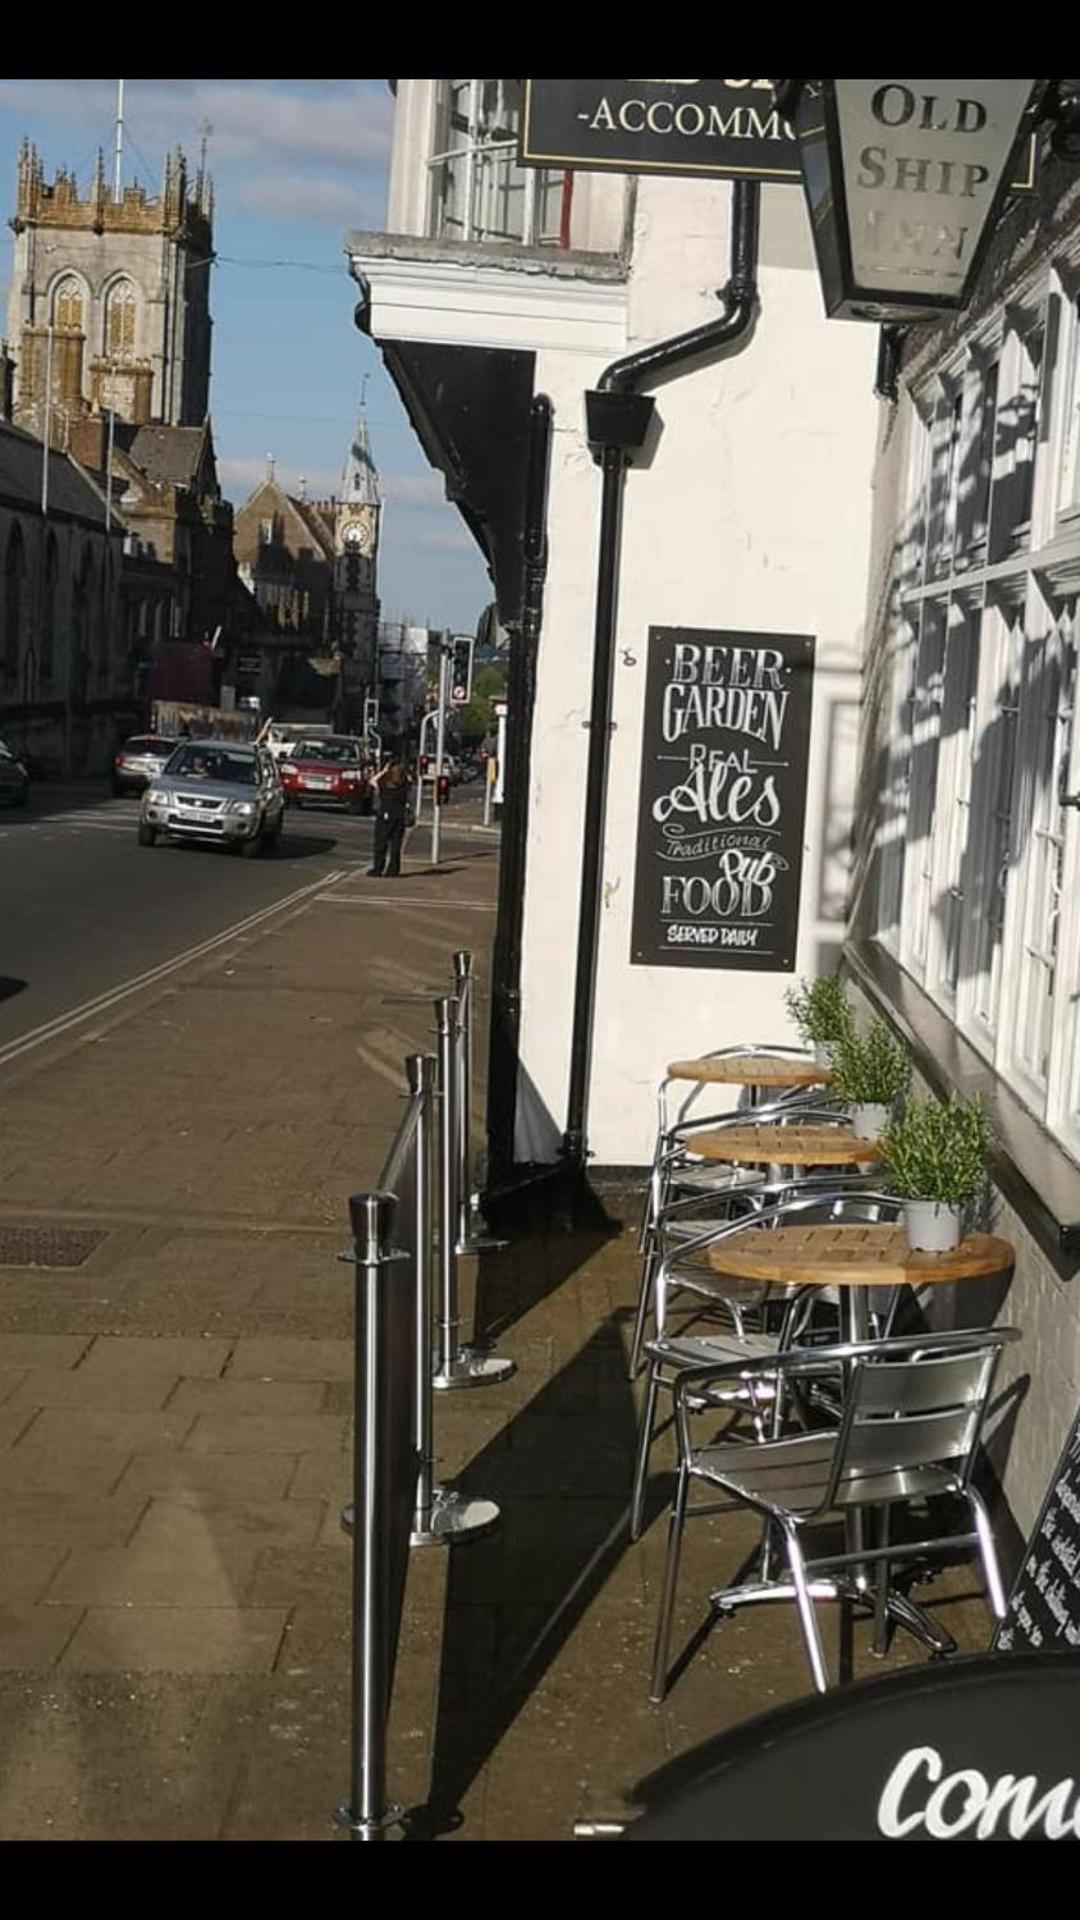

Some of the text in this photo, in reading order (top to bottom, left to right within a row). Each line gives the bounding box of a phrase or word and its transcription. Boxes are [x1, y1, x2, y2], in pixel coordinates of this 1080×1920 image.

[871, 83, 987, 133] OLD
[857, 146, 989, 198] SHIP
[673, 644, 785, 690] BEER
[662, 684, 791, 751] GARDEN
[689, 744, 758, 774] REAL
[652, 762, 781, 827] Ales
[666, 834, 772, 857] Traditional
[719, 849, 776, 887] Pub
[660, 876, 773, 917] FOOD
[667, 924, 759, 947] SERVED DAILY
[877, 1746, 1080, 1840] Com
